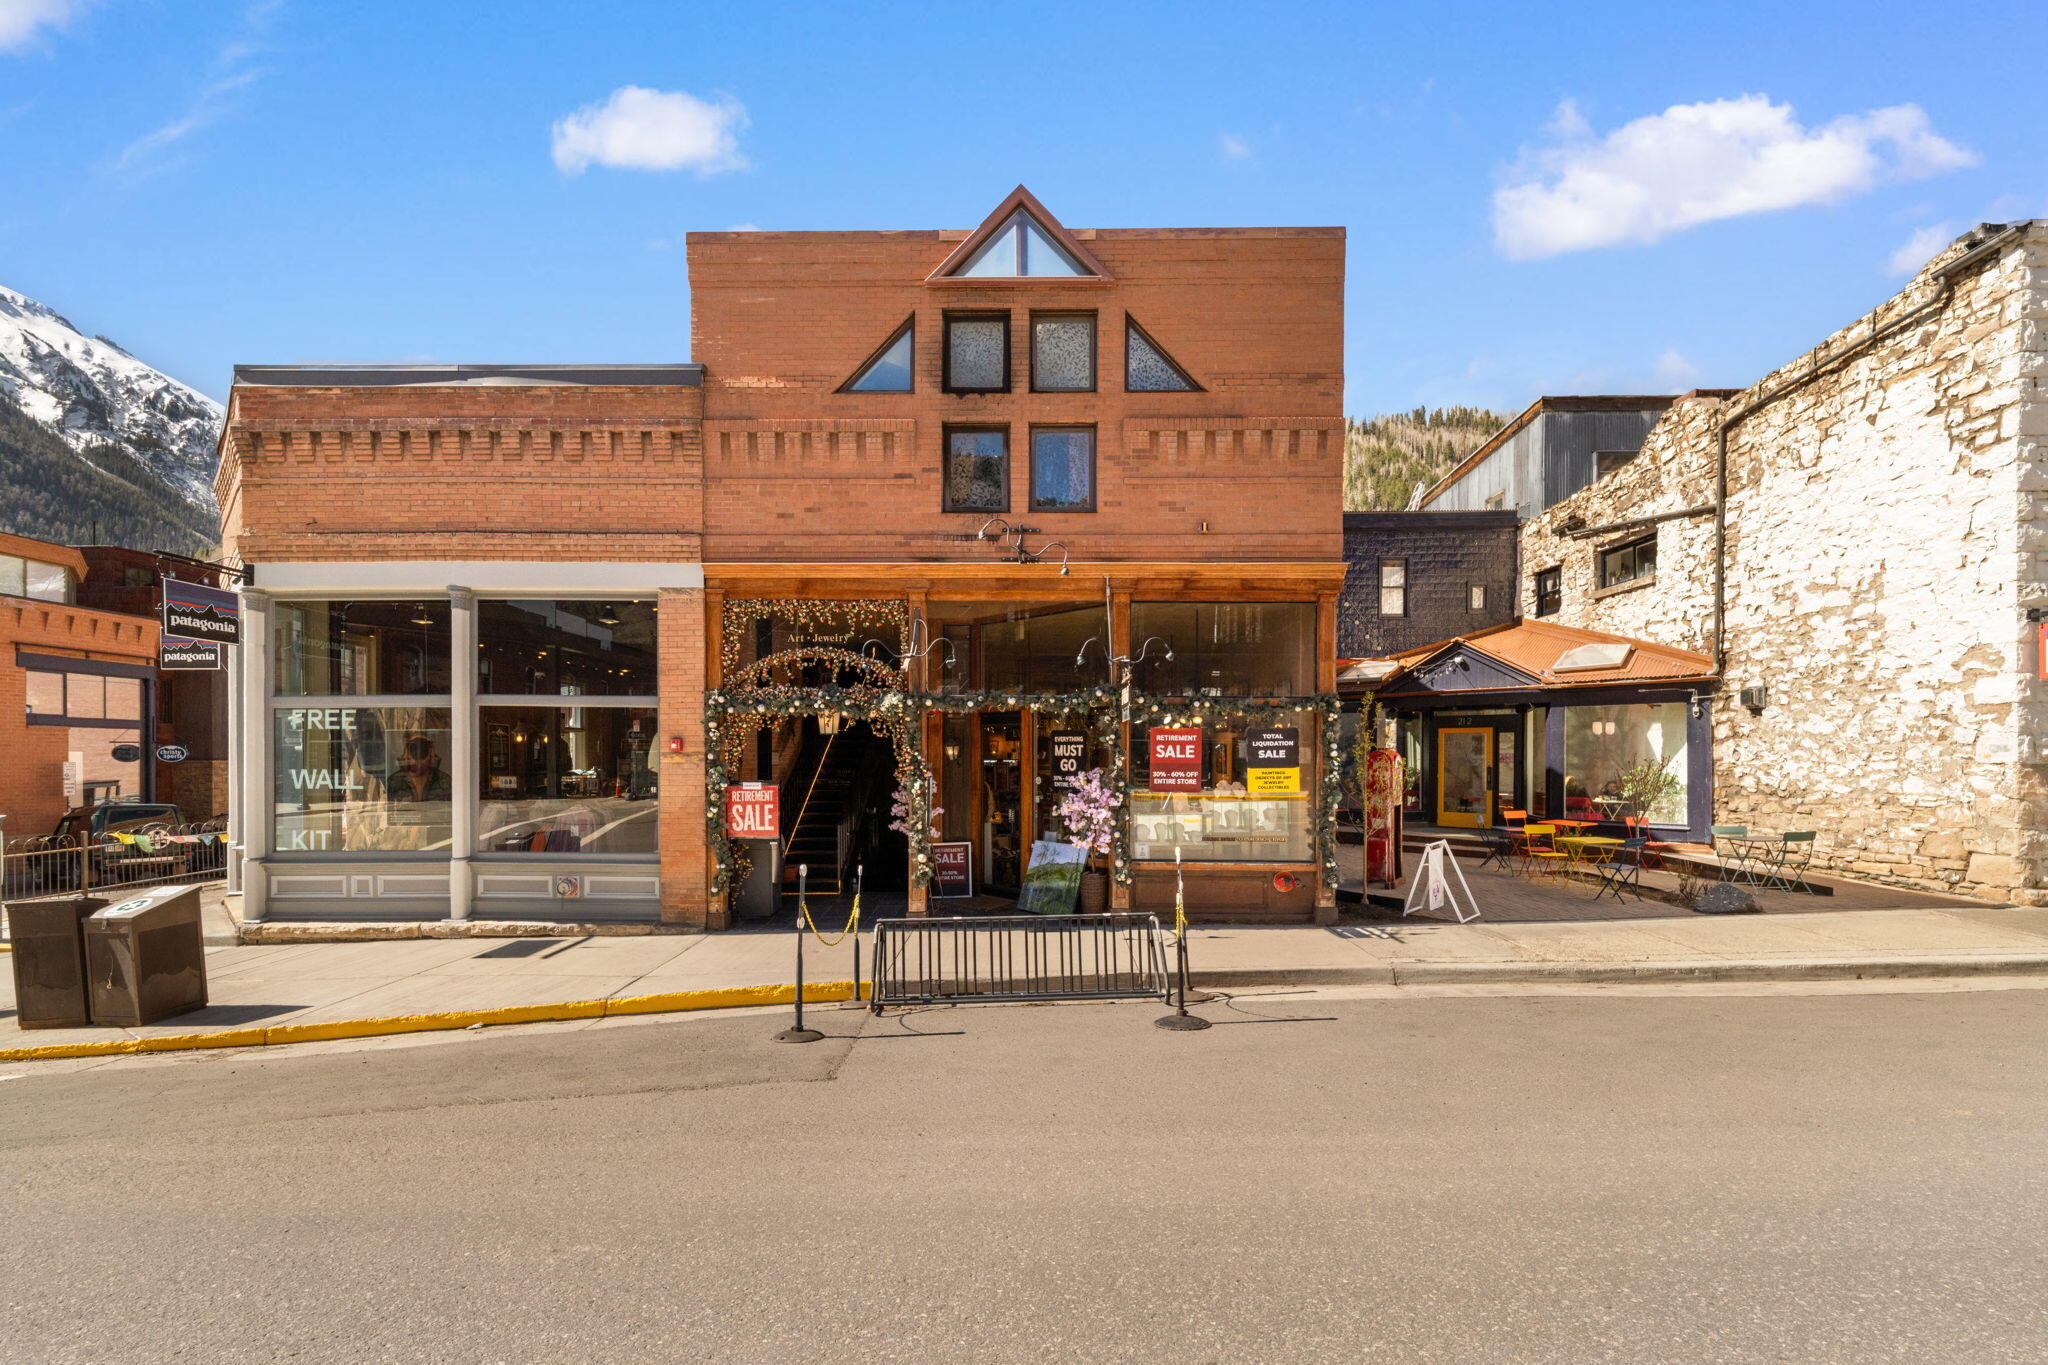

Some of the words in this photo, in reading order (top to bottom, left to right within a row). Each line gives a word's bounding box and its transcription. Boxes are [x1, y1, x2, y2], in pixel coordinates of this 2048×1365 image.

[170, 615, 236, 633] patagonia
[787, 633, 804, 642] Art
[812, 633, 848, 644] Jewelry
[164, 651, 215, 662] patagonia
[291, 709, 357, 730] FREE
[1054, 744, 1084, 757] MUST
[1155, 744, 1195, 758] SALE
[1258, 749, 1286, 758] SALE
[1060, 758, 1077, 772] GO
[291, 768, 364, 790] WALL
[731, 790, 774, 802] RETIREMENT
[732, 804, 774, 831] SALE
[291, 829, 332, 850] KIT
[935, 853, 965, 863] SALE
